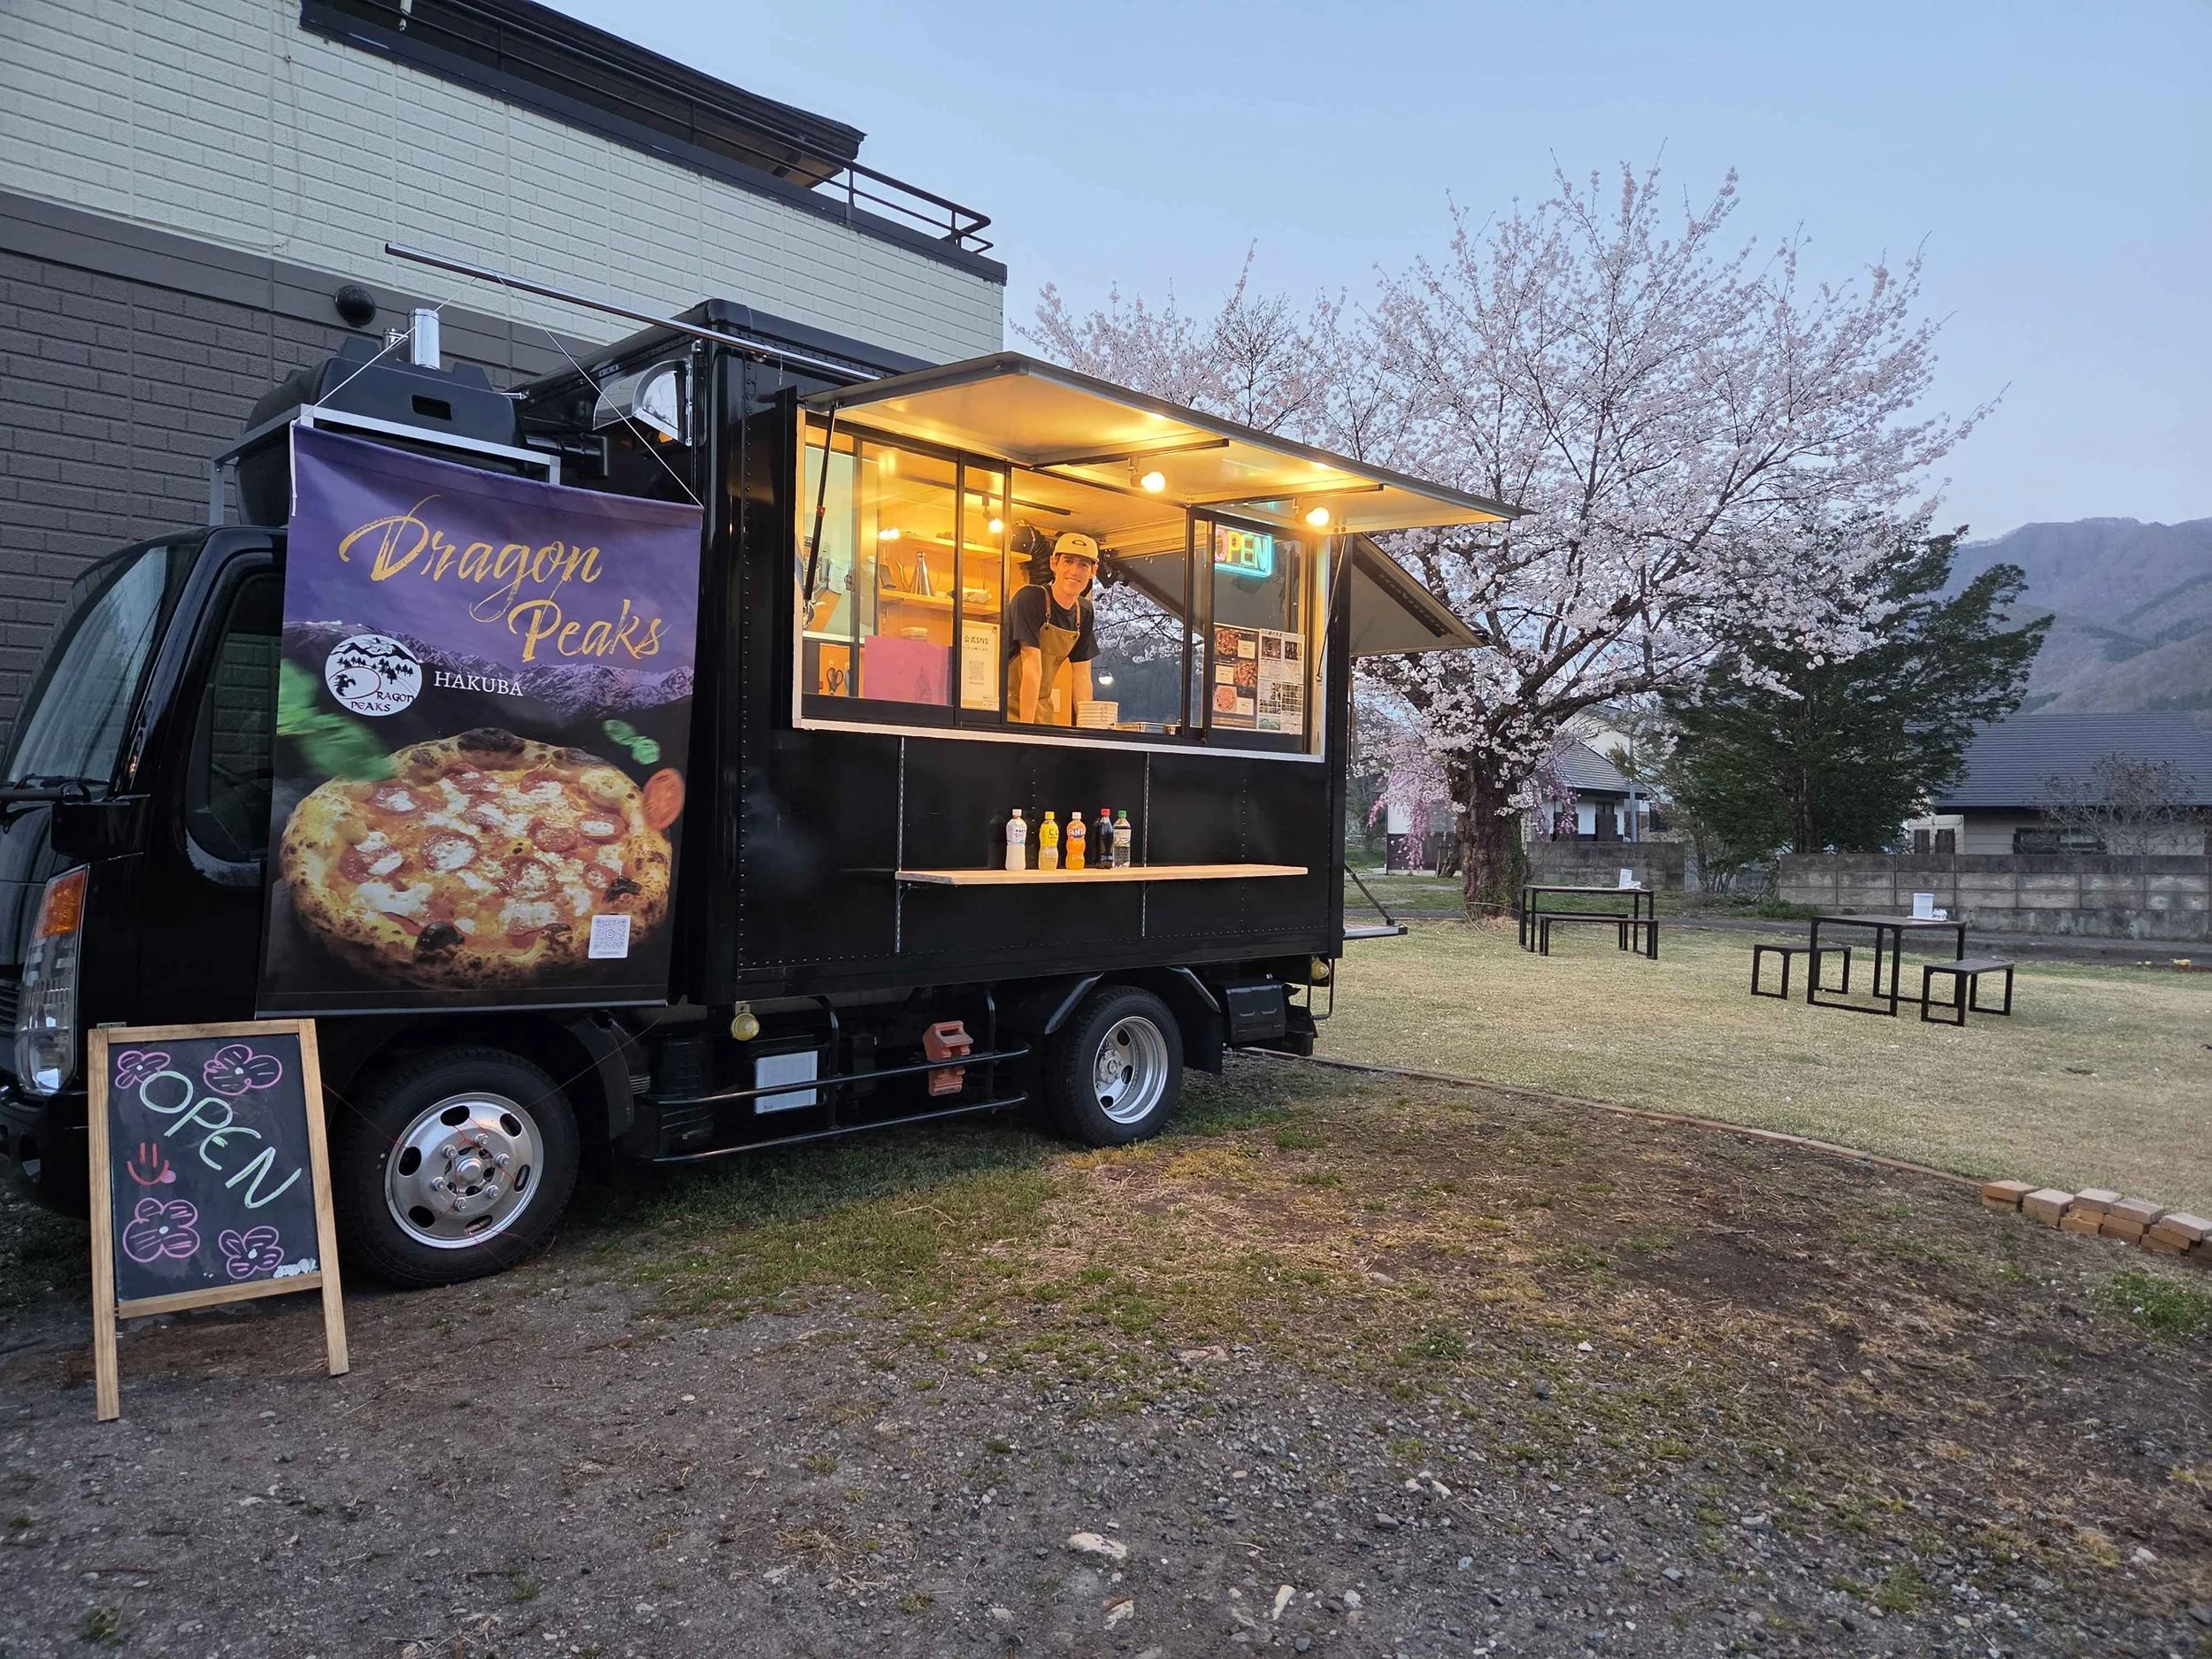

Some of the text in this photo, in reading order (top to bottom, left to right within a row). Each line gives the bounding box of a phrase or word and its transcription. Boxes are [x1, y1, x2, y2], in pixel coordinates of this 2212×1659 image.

[338, 494, 603, 623] Dragon
[1214, 528, 1269, 572] OPEN
[508, 580, 671, 663] Peaks
[350, 701, 391, 712] PEAKS
[434, 671, 525, 697] HAKUBA
[139, 1071, 303, 1209] OPEN
